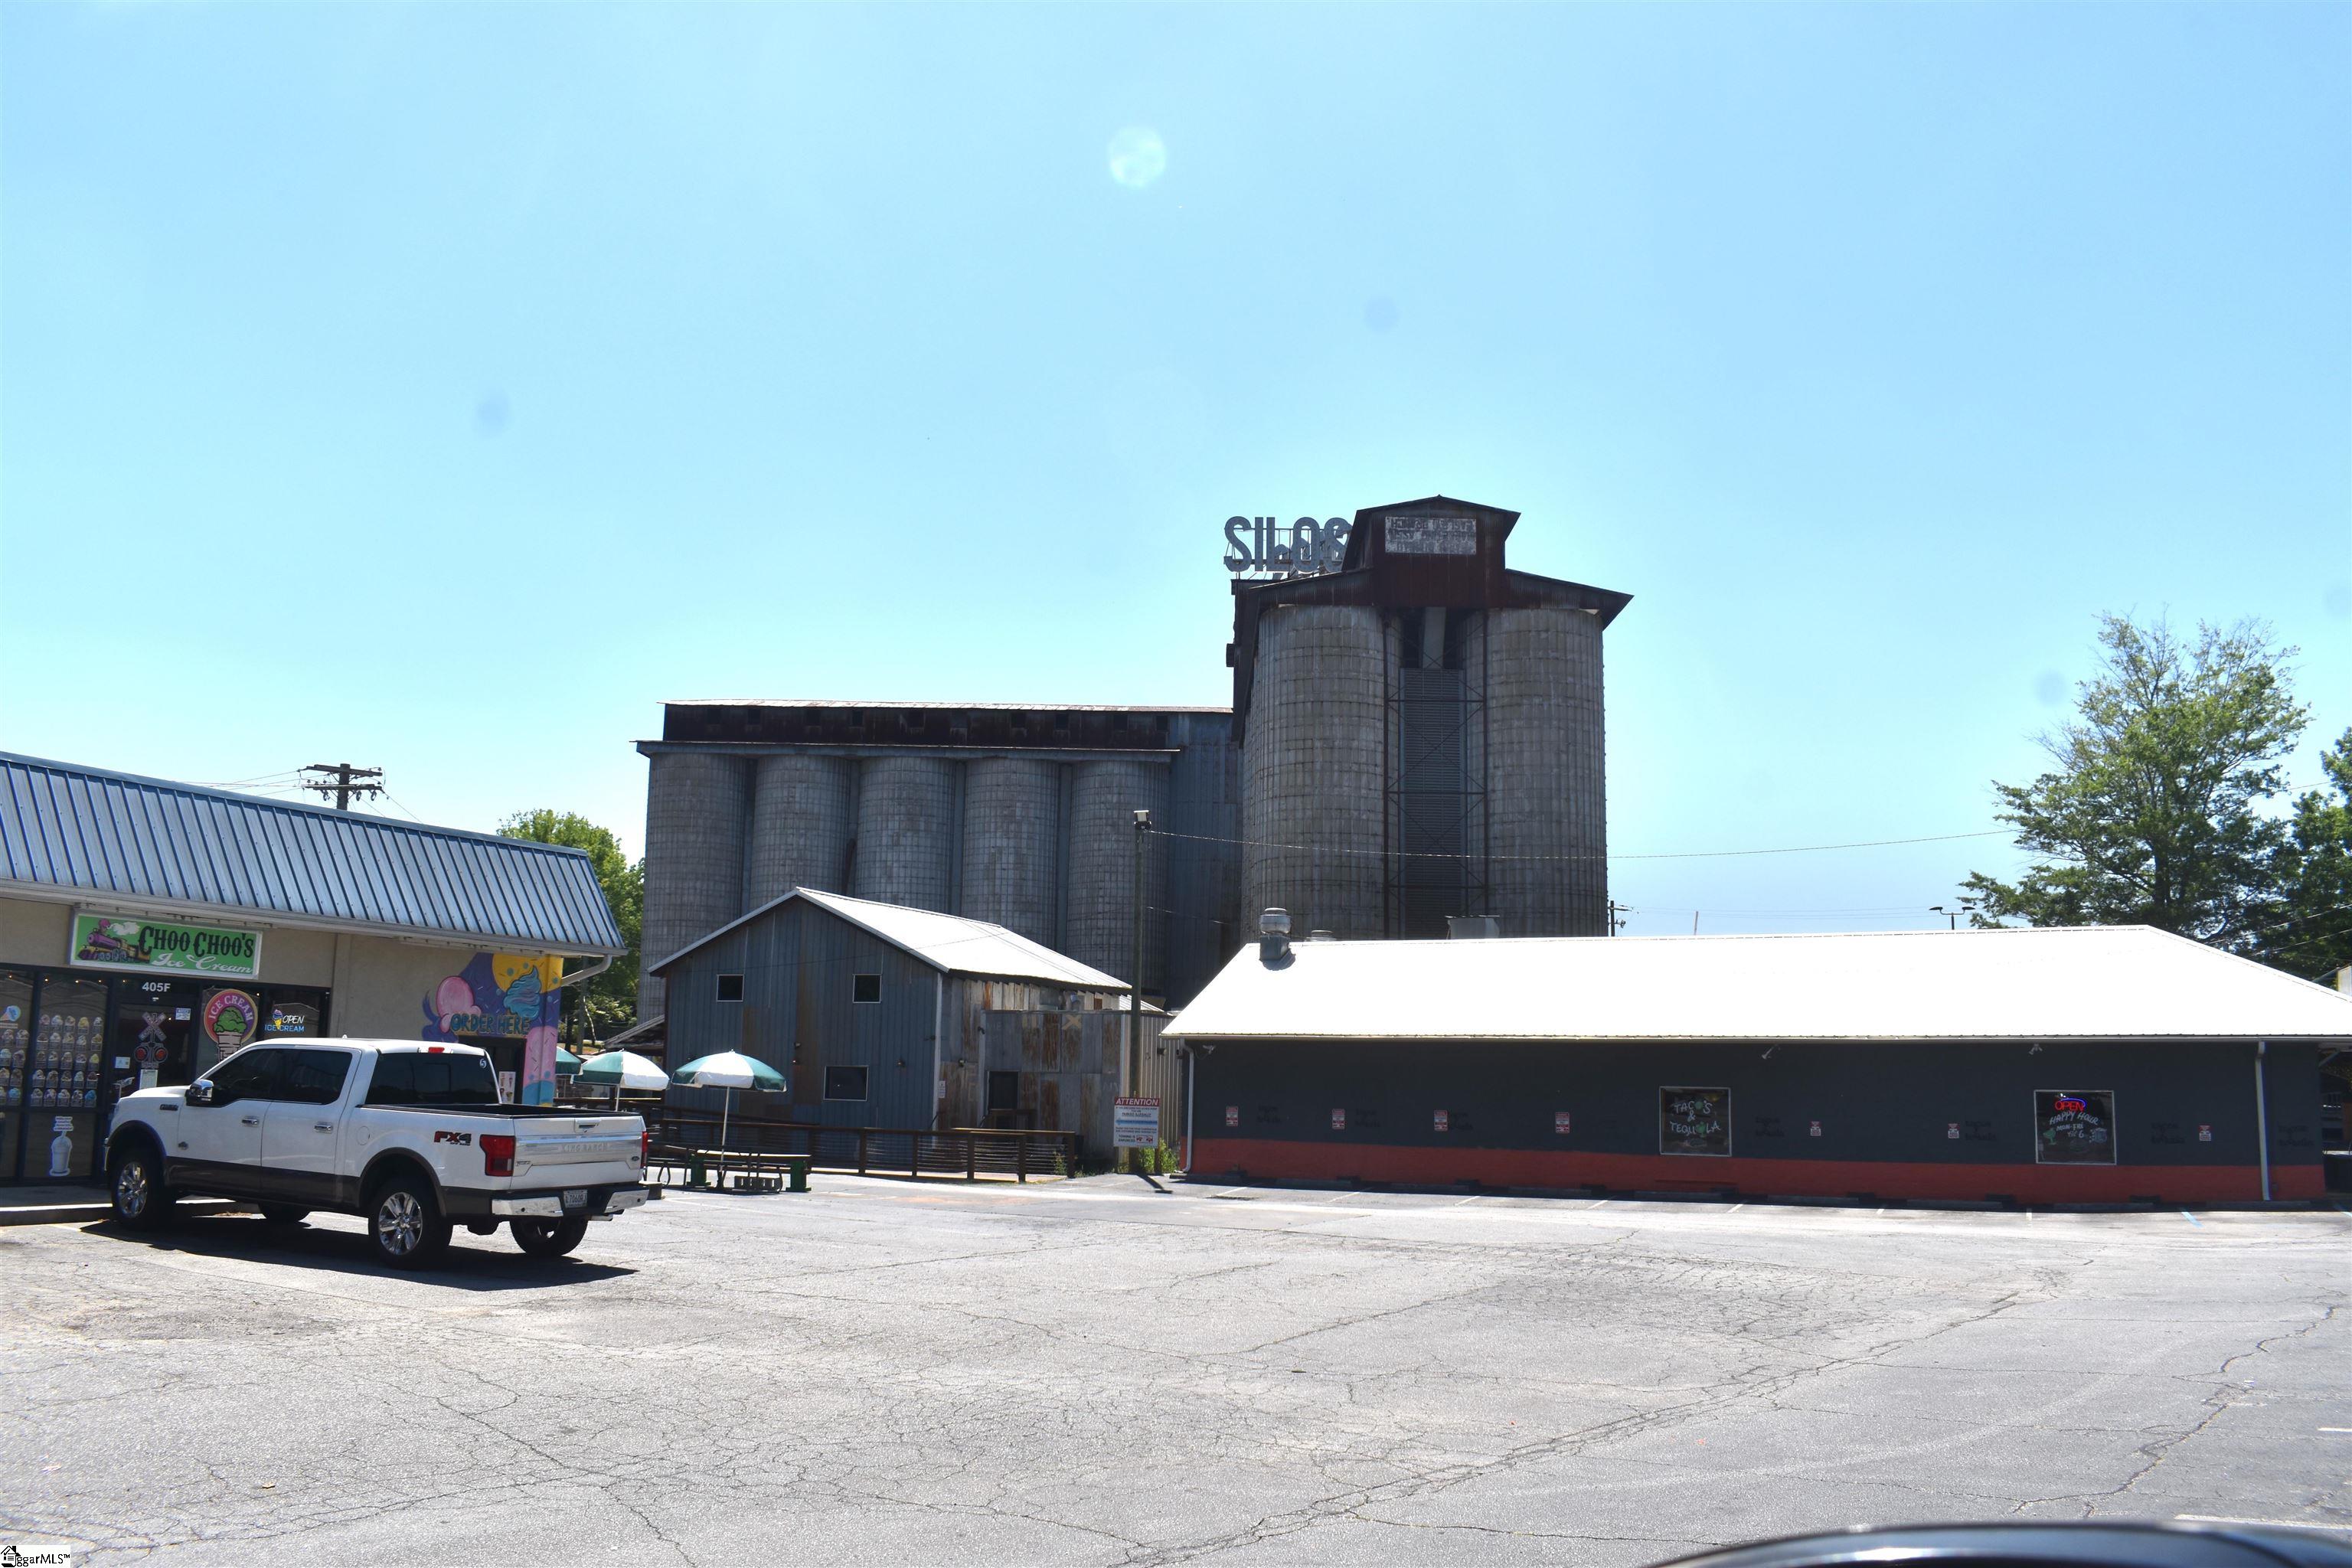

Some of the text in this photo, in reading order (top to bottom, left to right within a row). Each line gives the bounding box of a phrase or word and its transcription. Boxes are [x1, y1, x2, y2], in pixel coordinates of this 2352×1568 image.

[1223, 516, 1354, 573] SILOS
[139, 925, 254, 958] CHOO CHOO'S
[152, 952, 253, 974] Ice Cream
[142, 982, 171, 992] 405F
[208, 1000, 224, 1019] ICE
[224, 995, 254, 1021] CREAM
[282, 1014, 305, 1024] OPEN
[450, 1014, 531, 1034] ORDER HERE
[2055, 1100, 2084, 1111] OPEN
[2050, 1111, 2099, 1125] HAPPY HOUR
[433, 1131, 472, 1144] FX4
